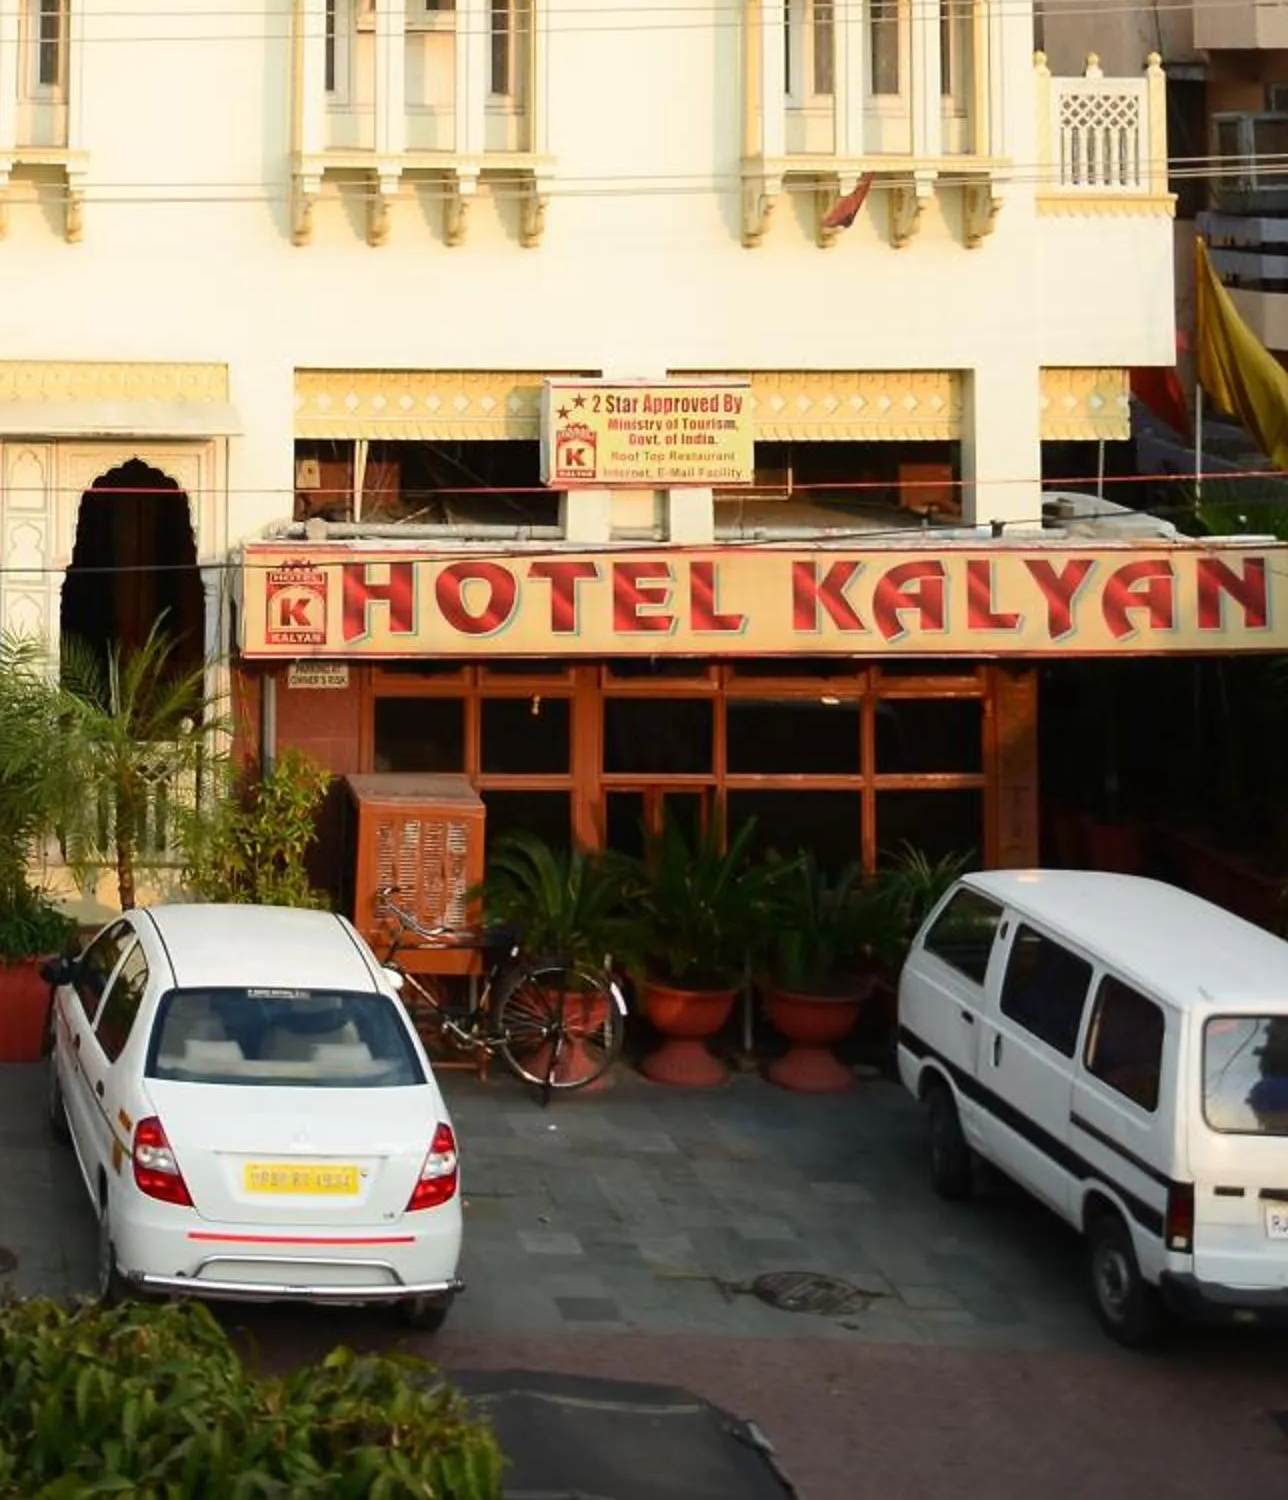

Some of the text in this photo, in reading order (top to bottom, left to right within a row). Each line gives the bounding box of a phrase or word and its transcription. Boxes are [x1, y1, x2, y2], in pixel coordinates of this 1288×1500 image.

[592, 394, 743, 415] 2 Star Approved By
[608, 418, 739, 432] Ministry of Tourism,
[664, 433, 678, 445] of
[565, 448, 586, 467] K
[611, 451, 736, 463] Roof Top Restaurant
[657, 468, 695, 478] E-Mail
[342, 557, 1269, 643] HOTEL KALYAN
[279, 598, 312, 627] K
[272, 632, 323, 642] KALYAN
